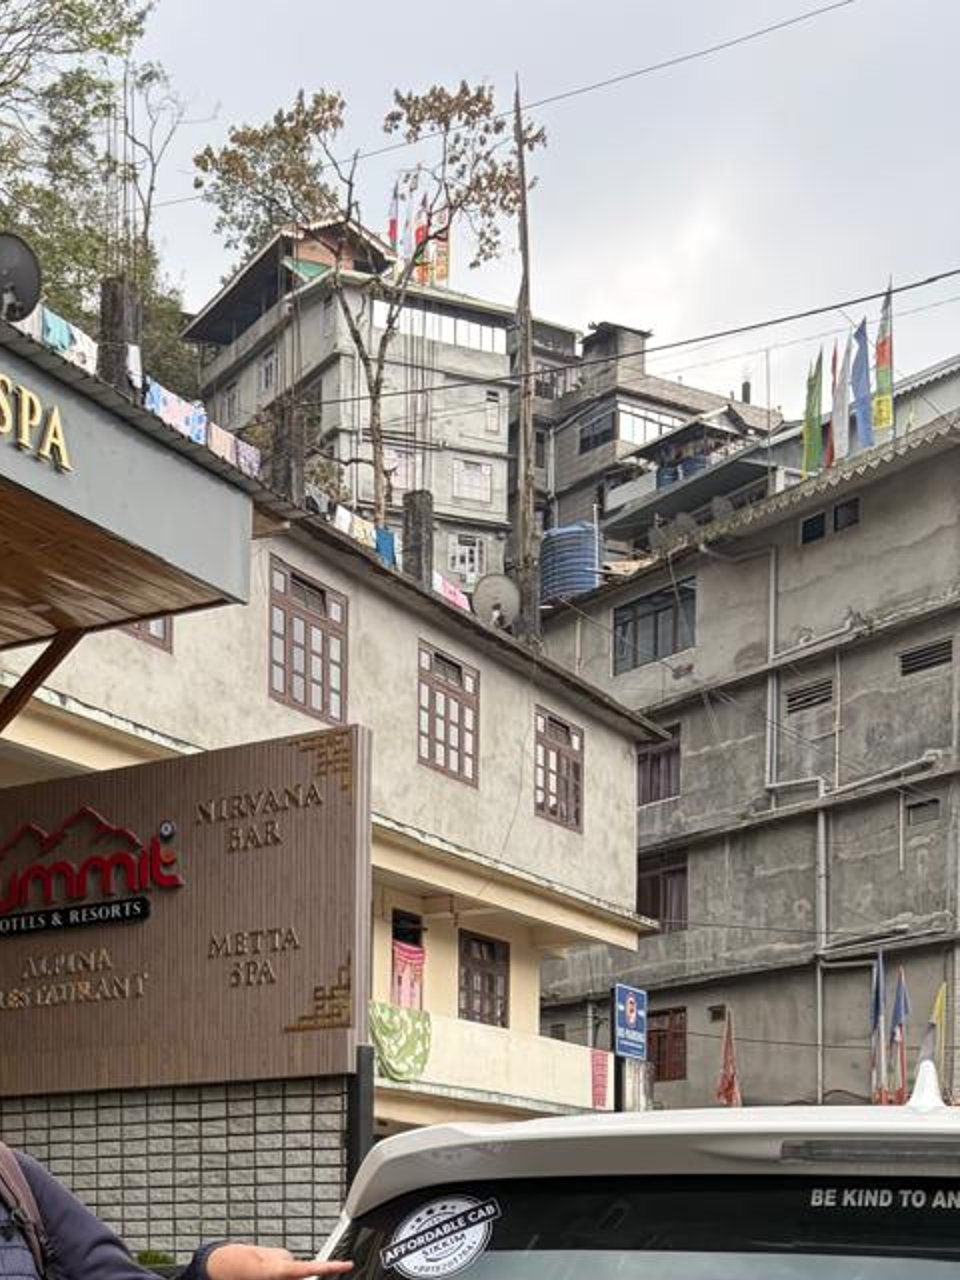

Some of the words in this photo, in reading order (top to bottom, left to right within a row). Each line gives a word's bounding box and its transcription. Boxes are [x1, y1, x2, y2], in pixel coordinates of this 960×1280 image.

[195, 783, 323, 825] NIRVANA
[227, 820, 283, 854] BAR
[50, 912, 63, 927] &
[68, 900, 142, 924] RESORTS
[208, 927, 301, 960] METTA
[229, 959, 277, 988] SPA
[810, 1188, 837, 1207] BE
[842, 1188, 893, 1207] KIND
[898, 1189, 927, 1208] TO
[384, 1217, 467, 1263] AFFORDABLE
[467, 1204, 496, 1223] CAB
[421, 1232, 467, 1258] SIKKIM
